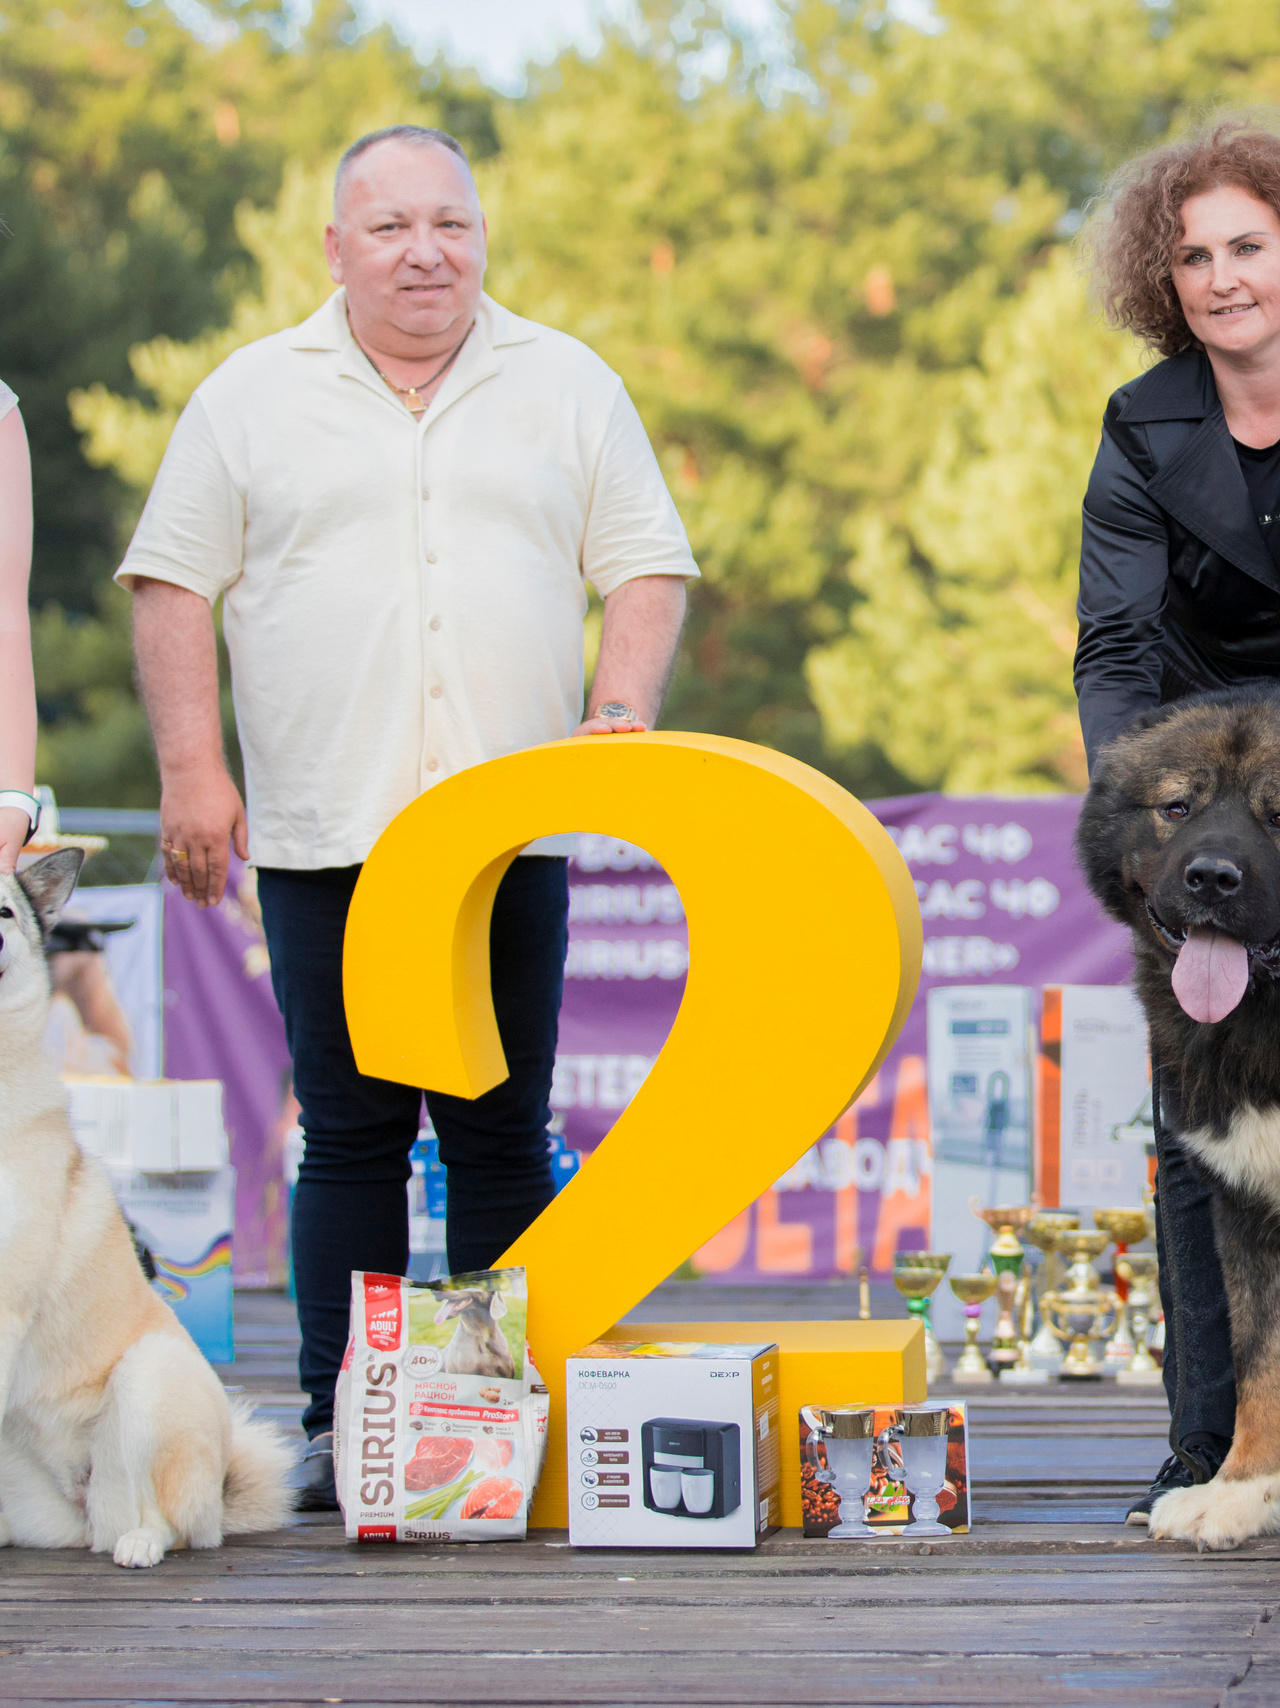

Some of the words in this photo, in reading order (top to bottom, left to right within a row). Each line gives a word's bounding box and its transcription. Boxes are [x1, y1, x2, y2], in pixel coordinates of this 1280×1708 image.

[370, 1320, 397, 1332] ADULT
[578, 1370, 631, 1378] КОФЕВАРКА
[414, 1381, 457, 1391] МЯСНОЙ
[414, 1391, 455, 1401] РАЦИОН
[482, 1410, 515, 1420] ProStor+
[359, 1361, 398, 1507] SIRIUS
[404, 1530, 450, 1540] SIRIUS
